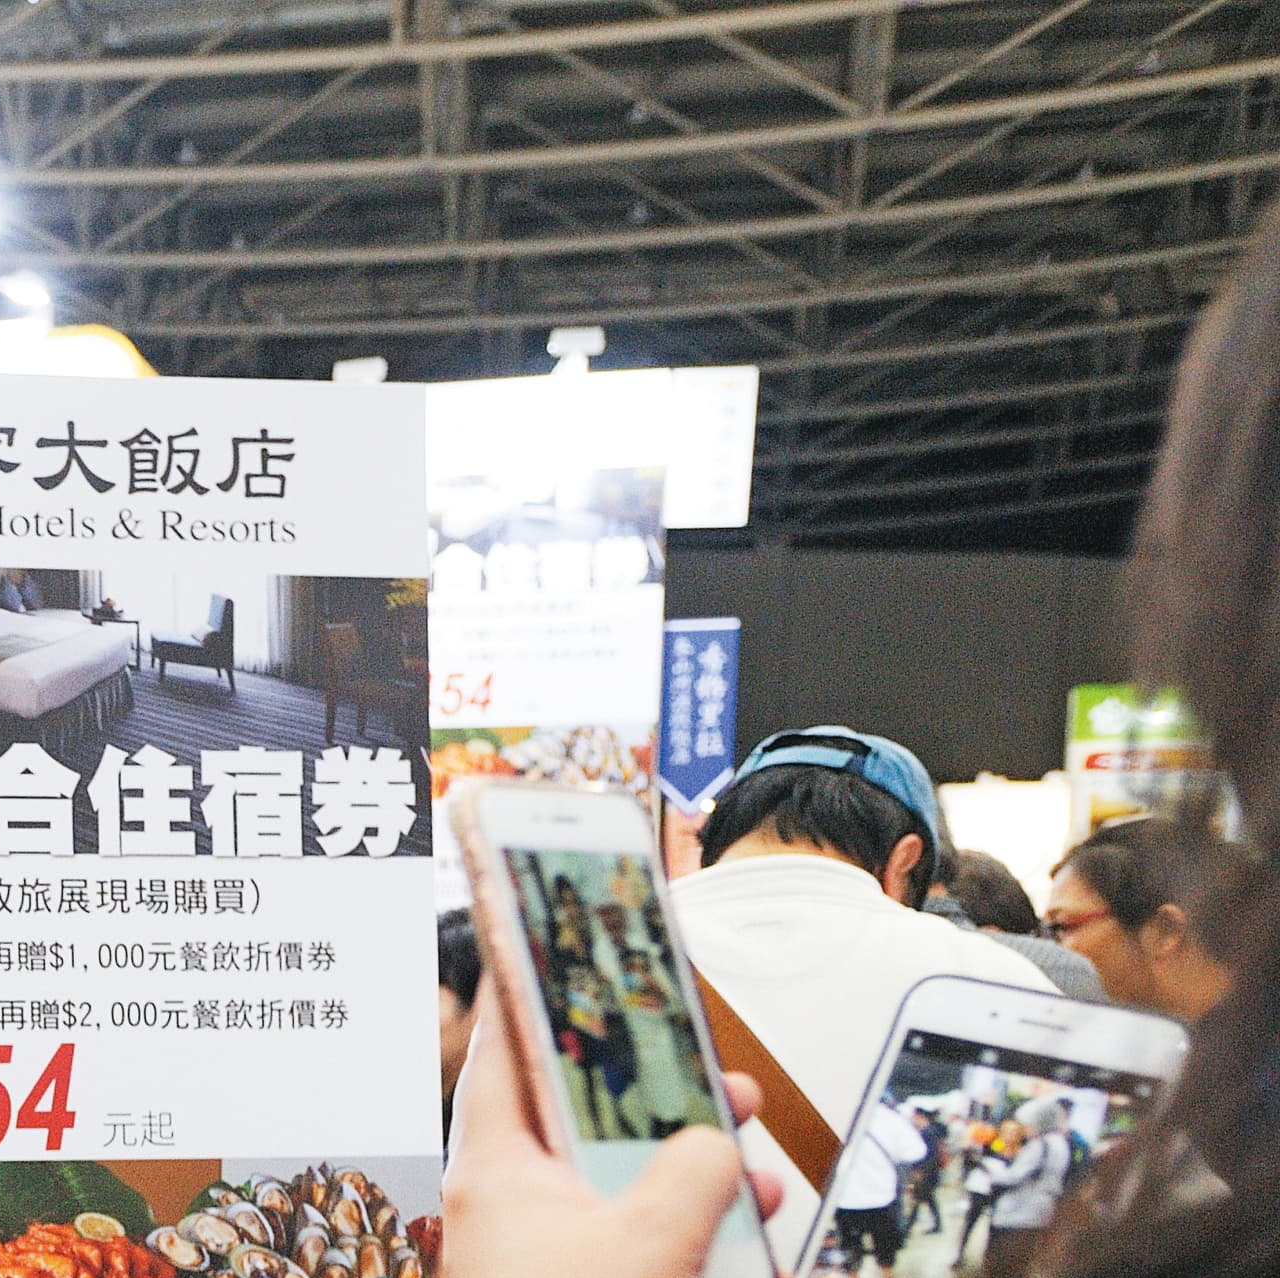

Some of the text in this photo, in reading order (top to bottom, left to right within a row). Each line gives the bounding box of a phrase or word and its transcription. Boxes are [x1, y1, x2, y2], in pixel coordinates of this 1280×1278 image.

[111, 508, 143, 541] &
[159, 509, 297, 544] Resorts
[427, 671, 494, 717] 54
[102, 1110, 176, 1148] 元起
